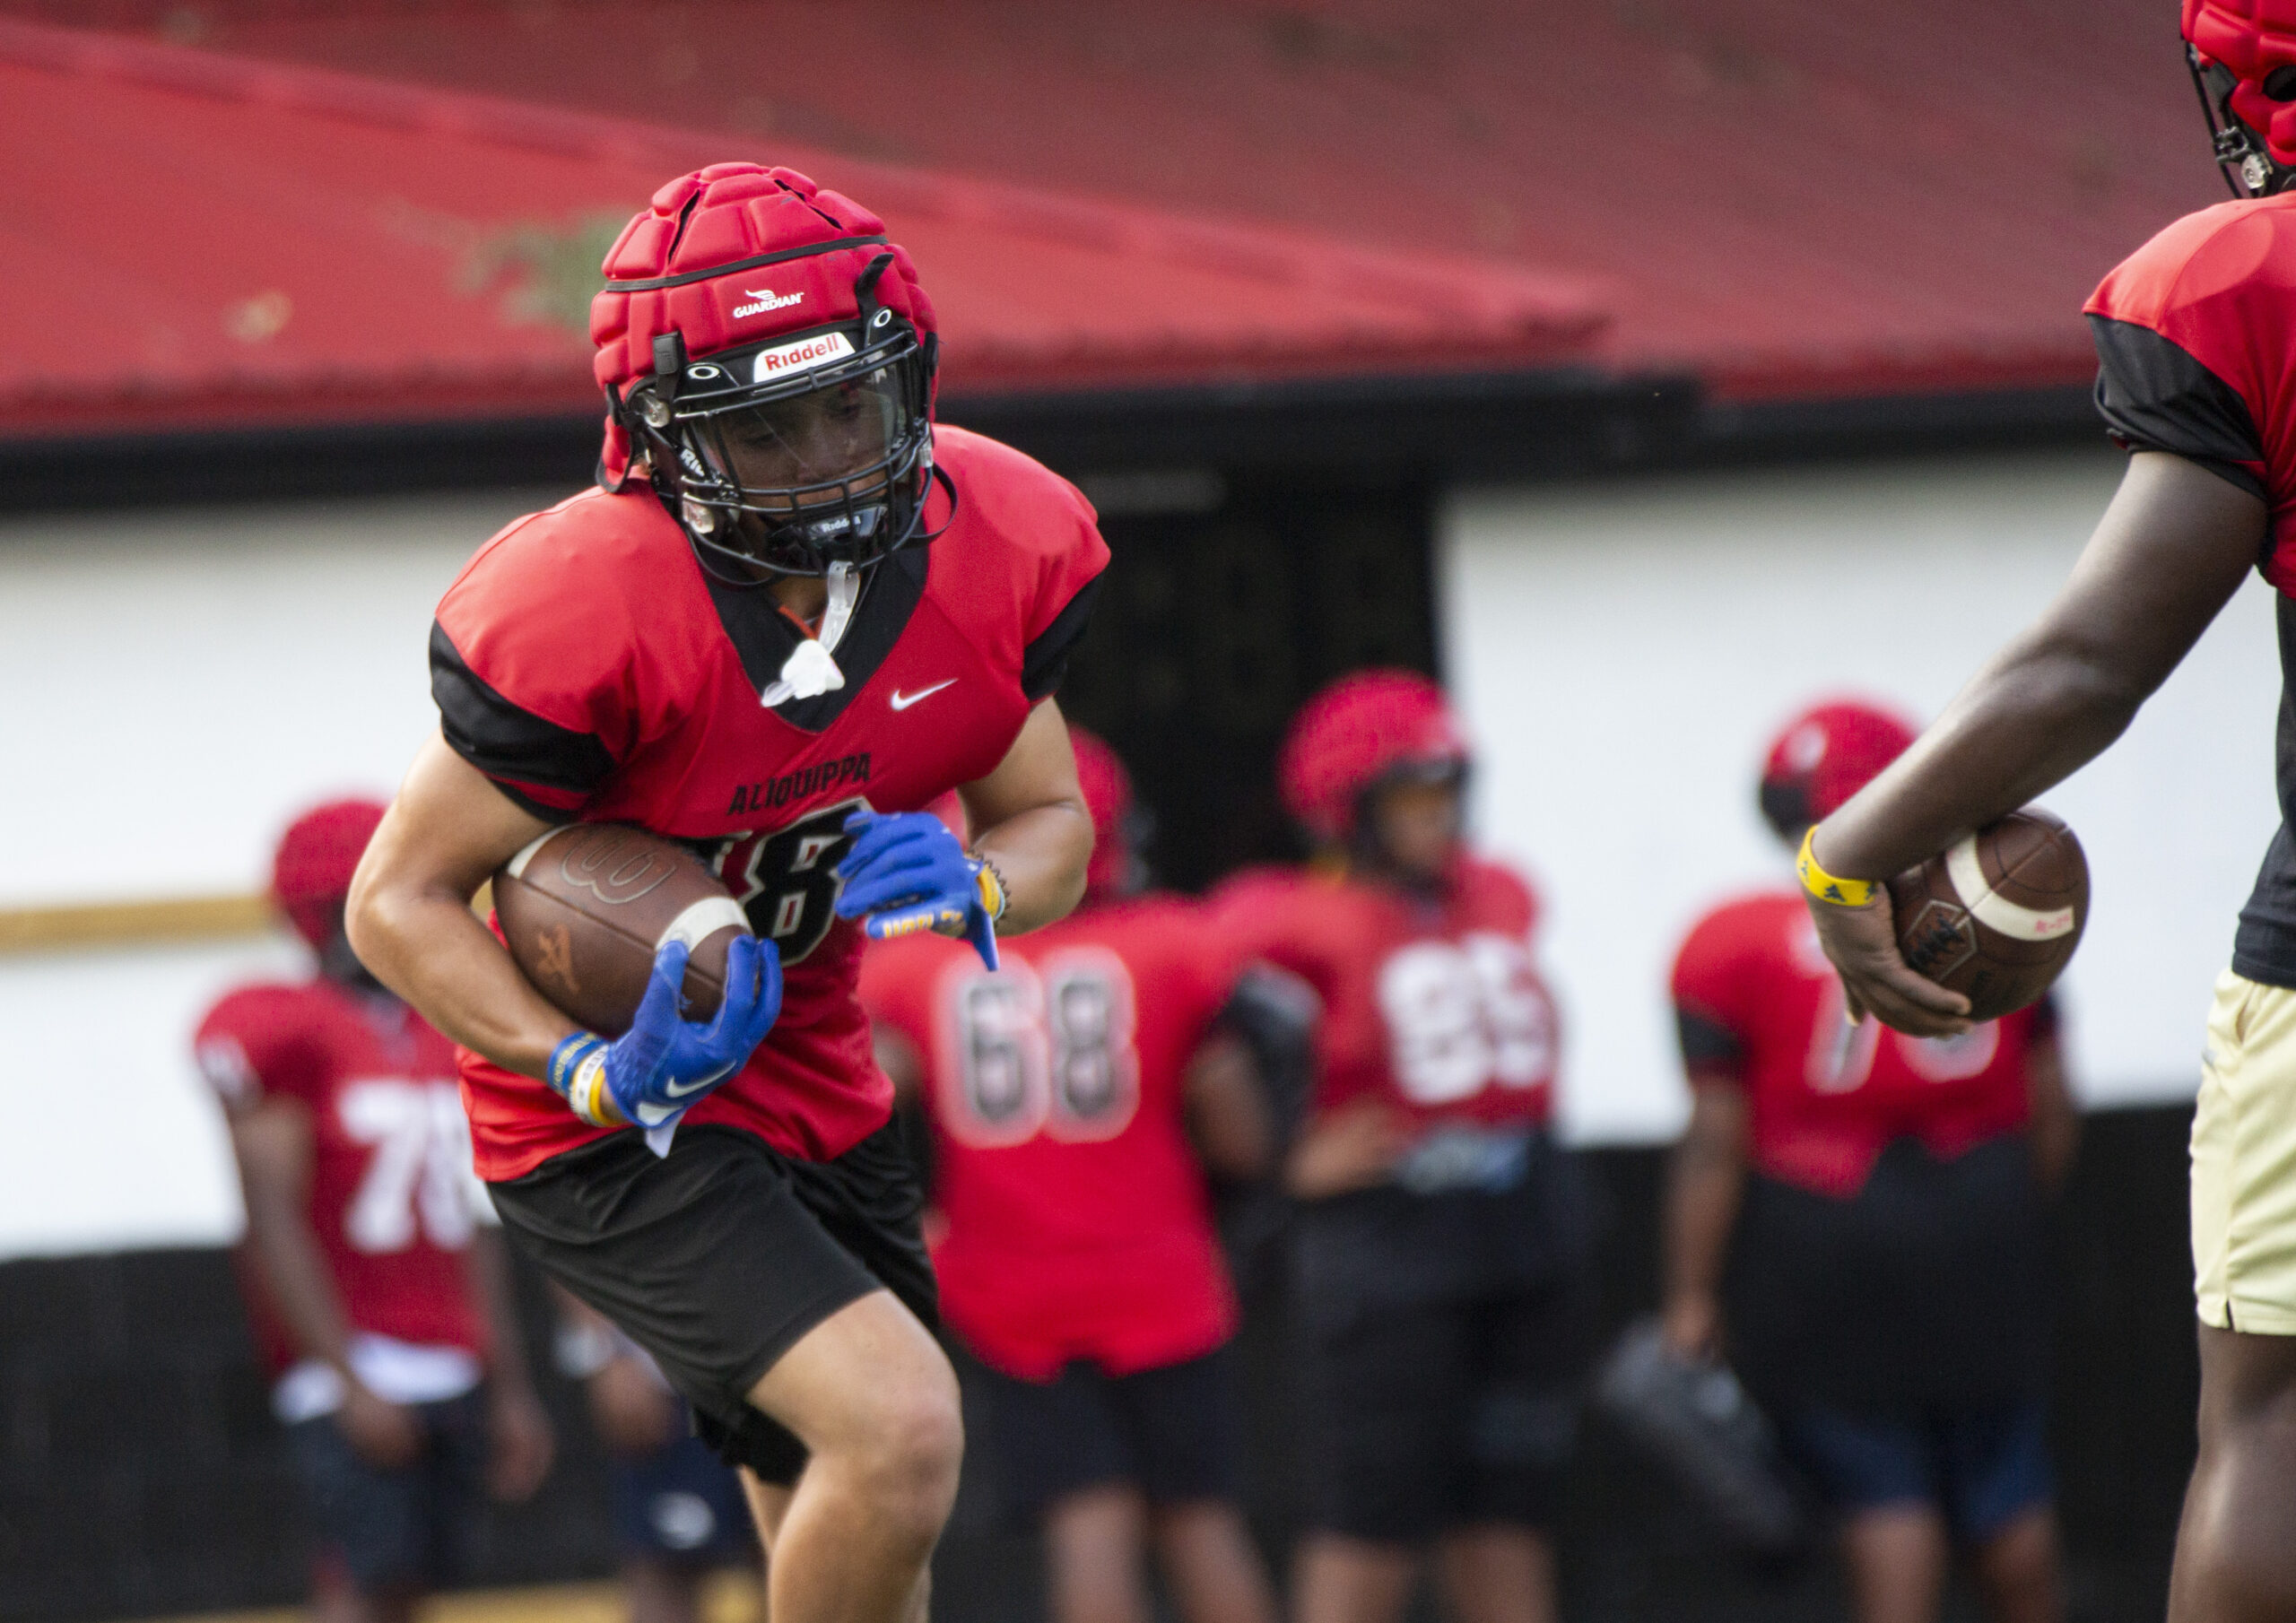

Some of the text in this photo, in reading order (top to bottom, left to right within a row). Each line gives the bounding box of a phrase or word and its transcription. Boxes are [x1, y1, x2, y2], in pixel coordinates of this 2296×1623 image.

[734, 292, 803, 318] GUARDIAN
[765, 334, 839, 370] Riddell
[726, 752, 871, 815] ALIQUIPPA
[935, 944, 1139, 1148] 68
